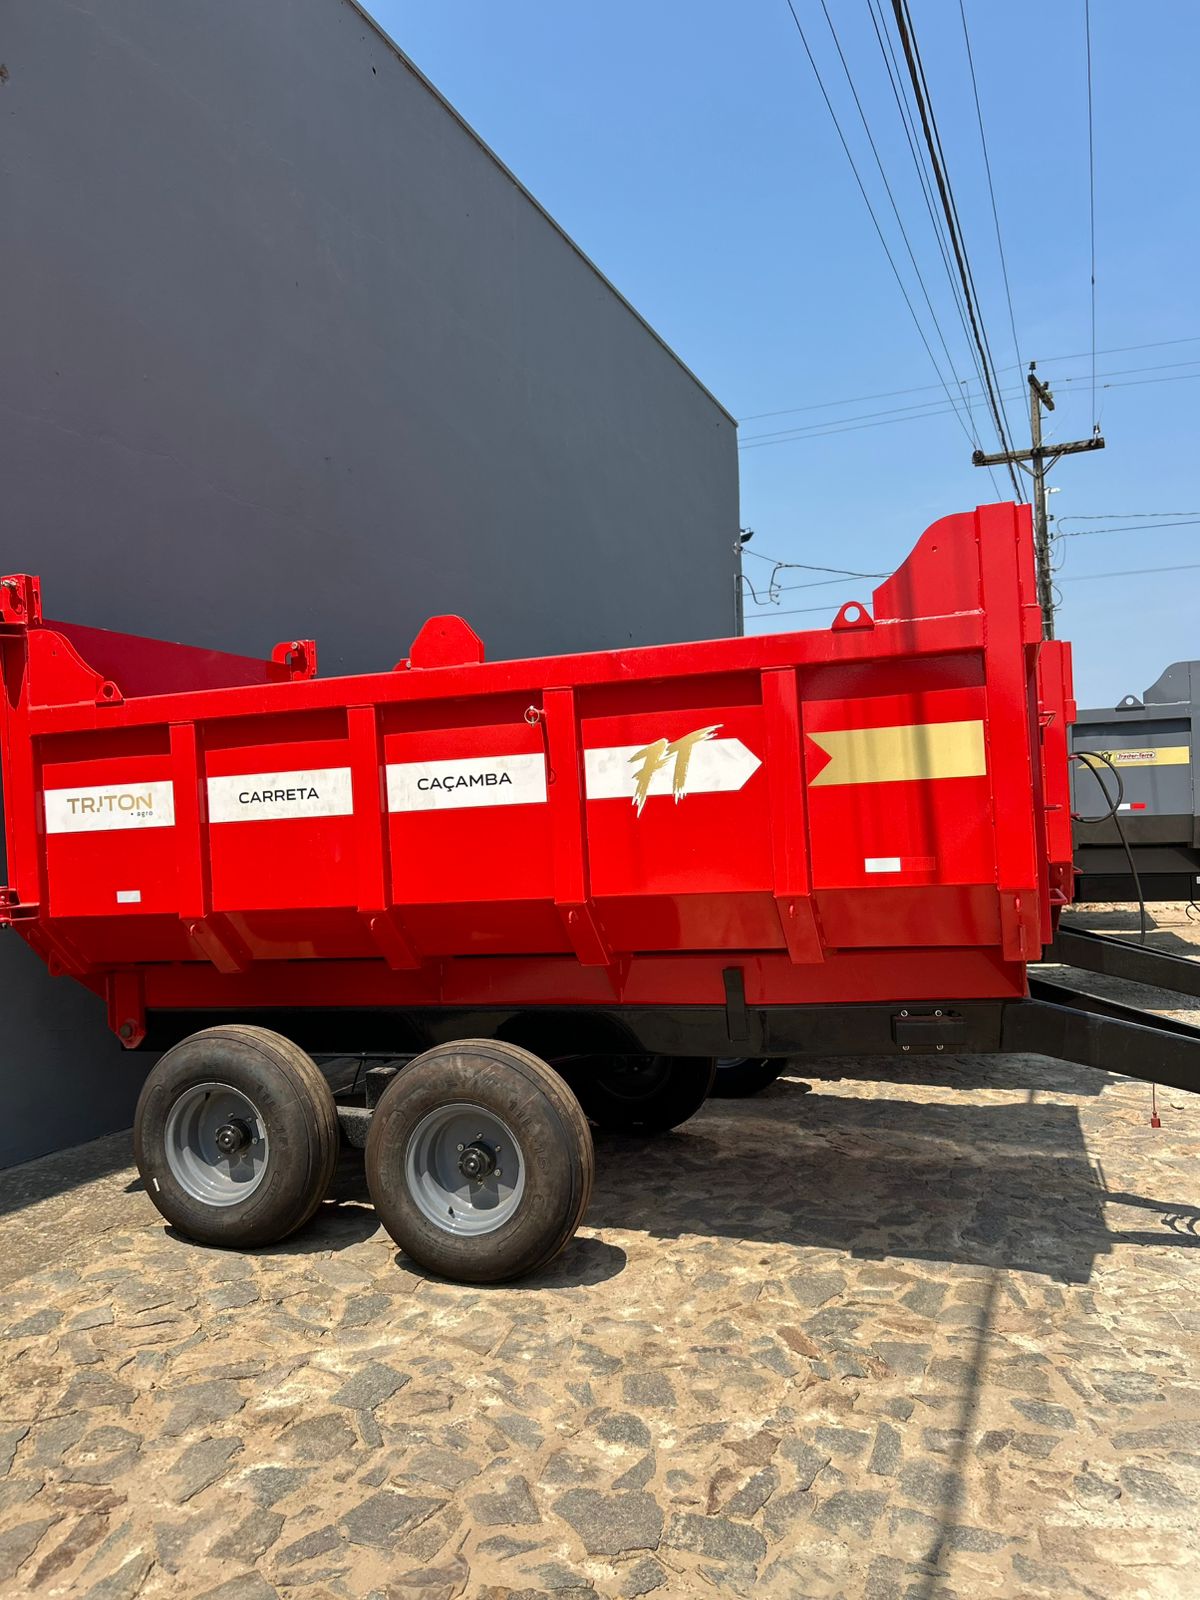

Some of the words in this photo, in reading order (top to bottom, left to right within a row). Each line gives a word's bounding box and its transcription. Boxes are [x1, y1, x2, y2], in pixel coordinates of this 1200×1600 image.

[417, 772, 512, 793] CAÇAMBA
[238, 787, 320, 804] CARRETA
[136, 810, 154, 818] agro
